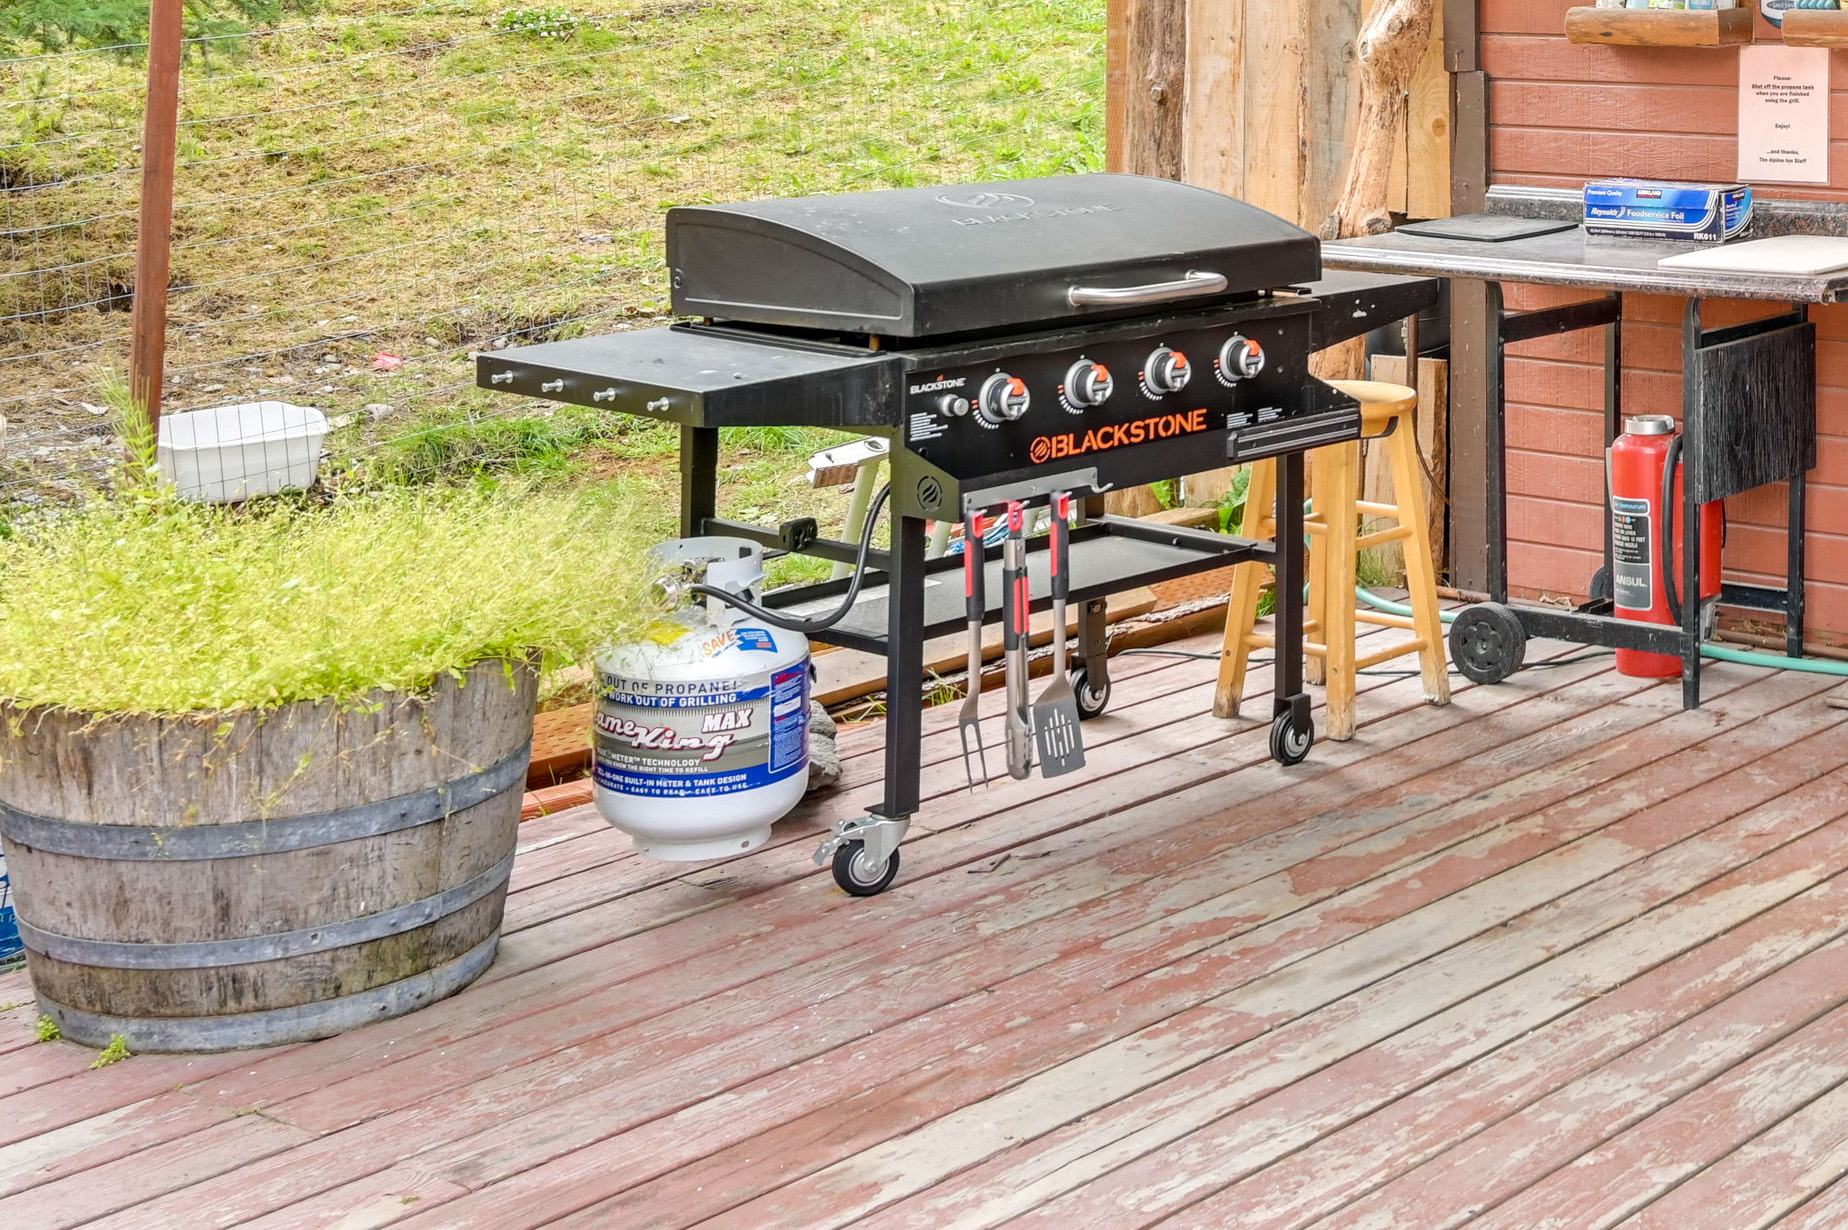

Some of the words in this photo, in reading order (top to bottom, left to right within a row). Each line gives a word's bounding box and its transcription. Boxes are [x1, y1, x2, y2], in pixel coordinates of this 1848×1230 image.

[1591, 207, 1618, 216] Reynolds
[1627, 209, 1669, 219] Foodservice
[1671, 212, 1684, 220] Foil
[910, 377, 966, 394] BLACKSTONE
[1050, 408, 1208, 459] BLACKSTONE
[703, 630, 735, 656] SAVE
[606, 675, 627, 690] OUT
[632, 682, 649, 692] OF
[655, 681, 738, 695] PROPANE!
[609, 692, 633, 705] WORK
[636, 695, 657, 707] OUT
[660, 697, 676, 707] OF
[596, 712, 635, 736] ame
[701, 708, 753, 734] MAX
[613, 761, 626, 769] KNOW
[642, 758, 700, 767] TECHNOLOGY
[600, 778, 624, 790] ACCURATE
[625, 777, 655, 786] BUILT-IN
[693, 778, 715, 786] TANK
[717, 773, 747, 784] DESIGN
